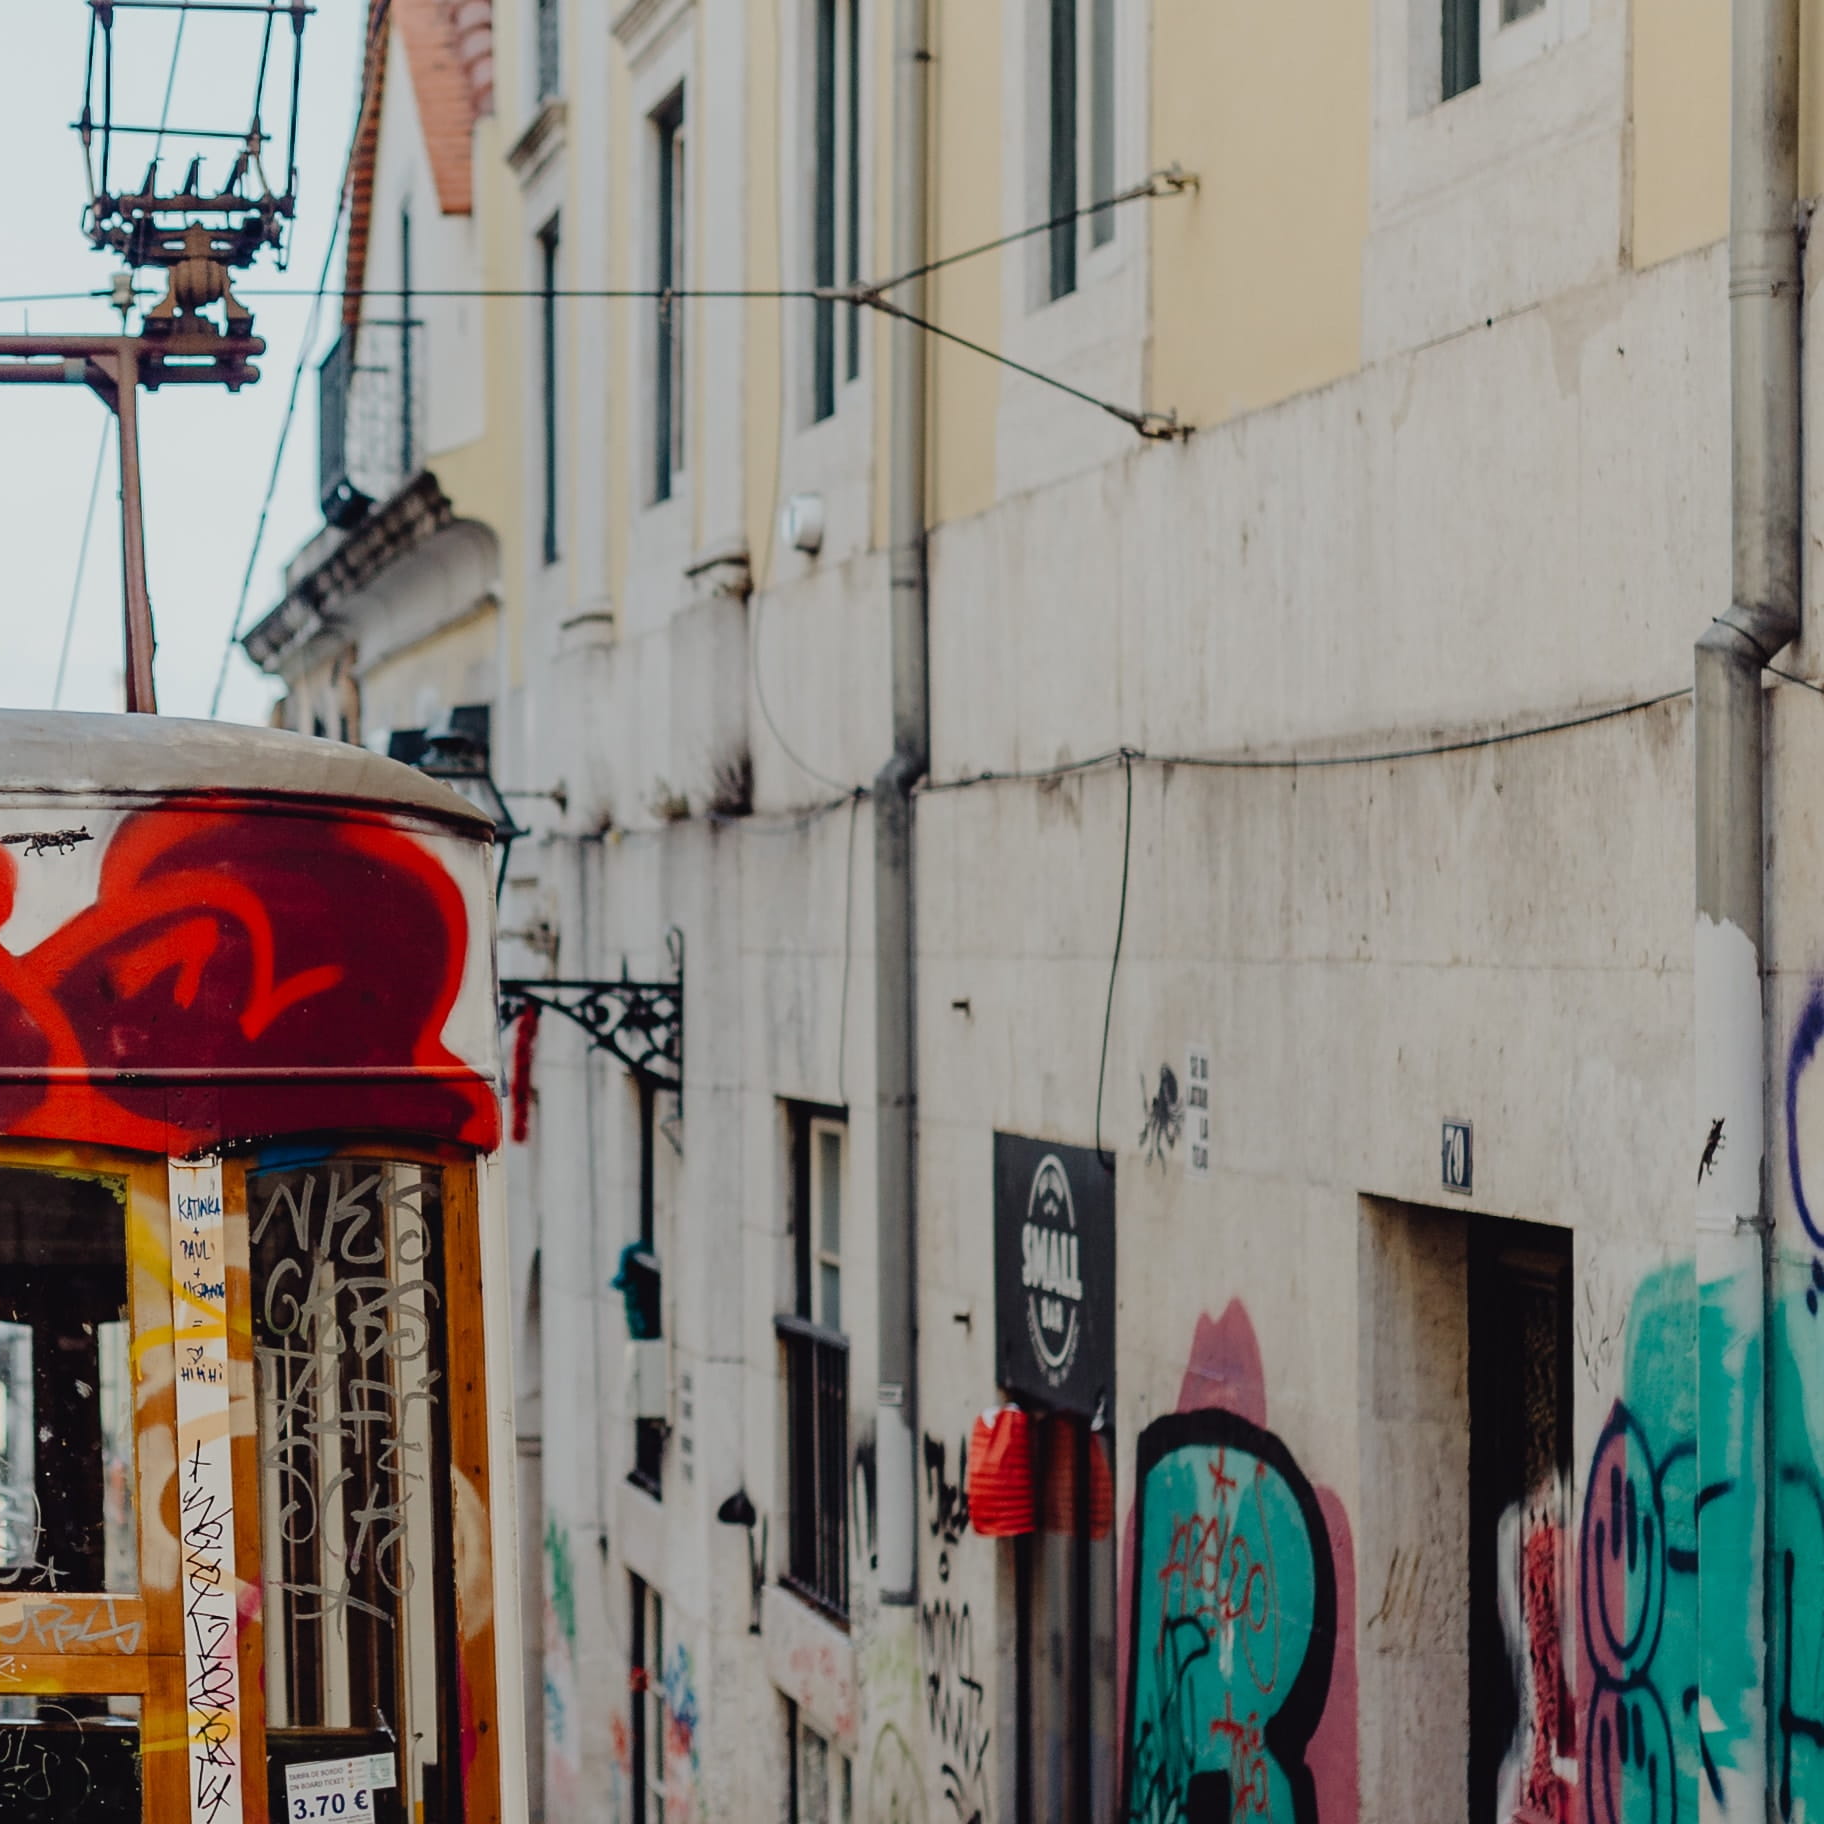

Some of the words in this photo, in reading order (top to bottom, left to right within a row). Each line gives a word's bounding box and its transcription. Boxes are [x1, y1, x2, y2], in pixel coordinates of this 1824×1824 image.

[180, 1239, 211, 1263] PAUL
[1022, 1221, 1083, 1302] SMALL
[301, 1779, 323, 1789] BOARD
[324, 1777, 345, 1787] TICKET
[293, 1793, 345, 1820] 3.70
[354, 1789, 369, 1810] €
